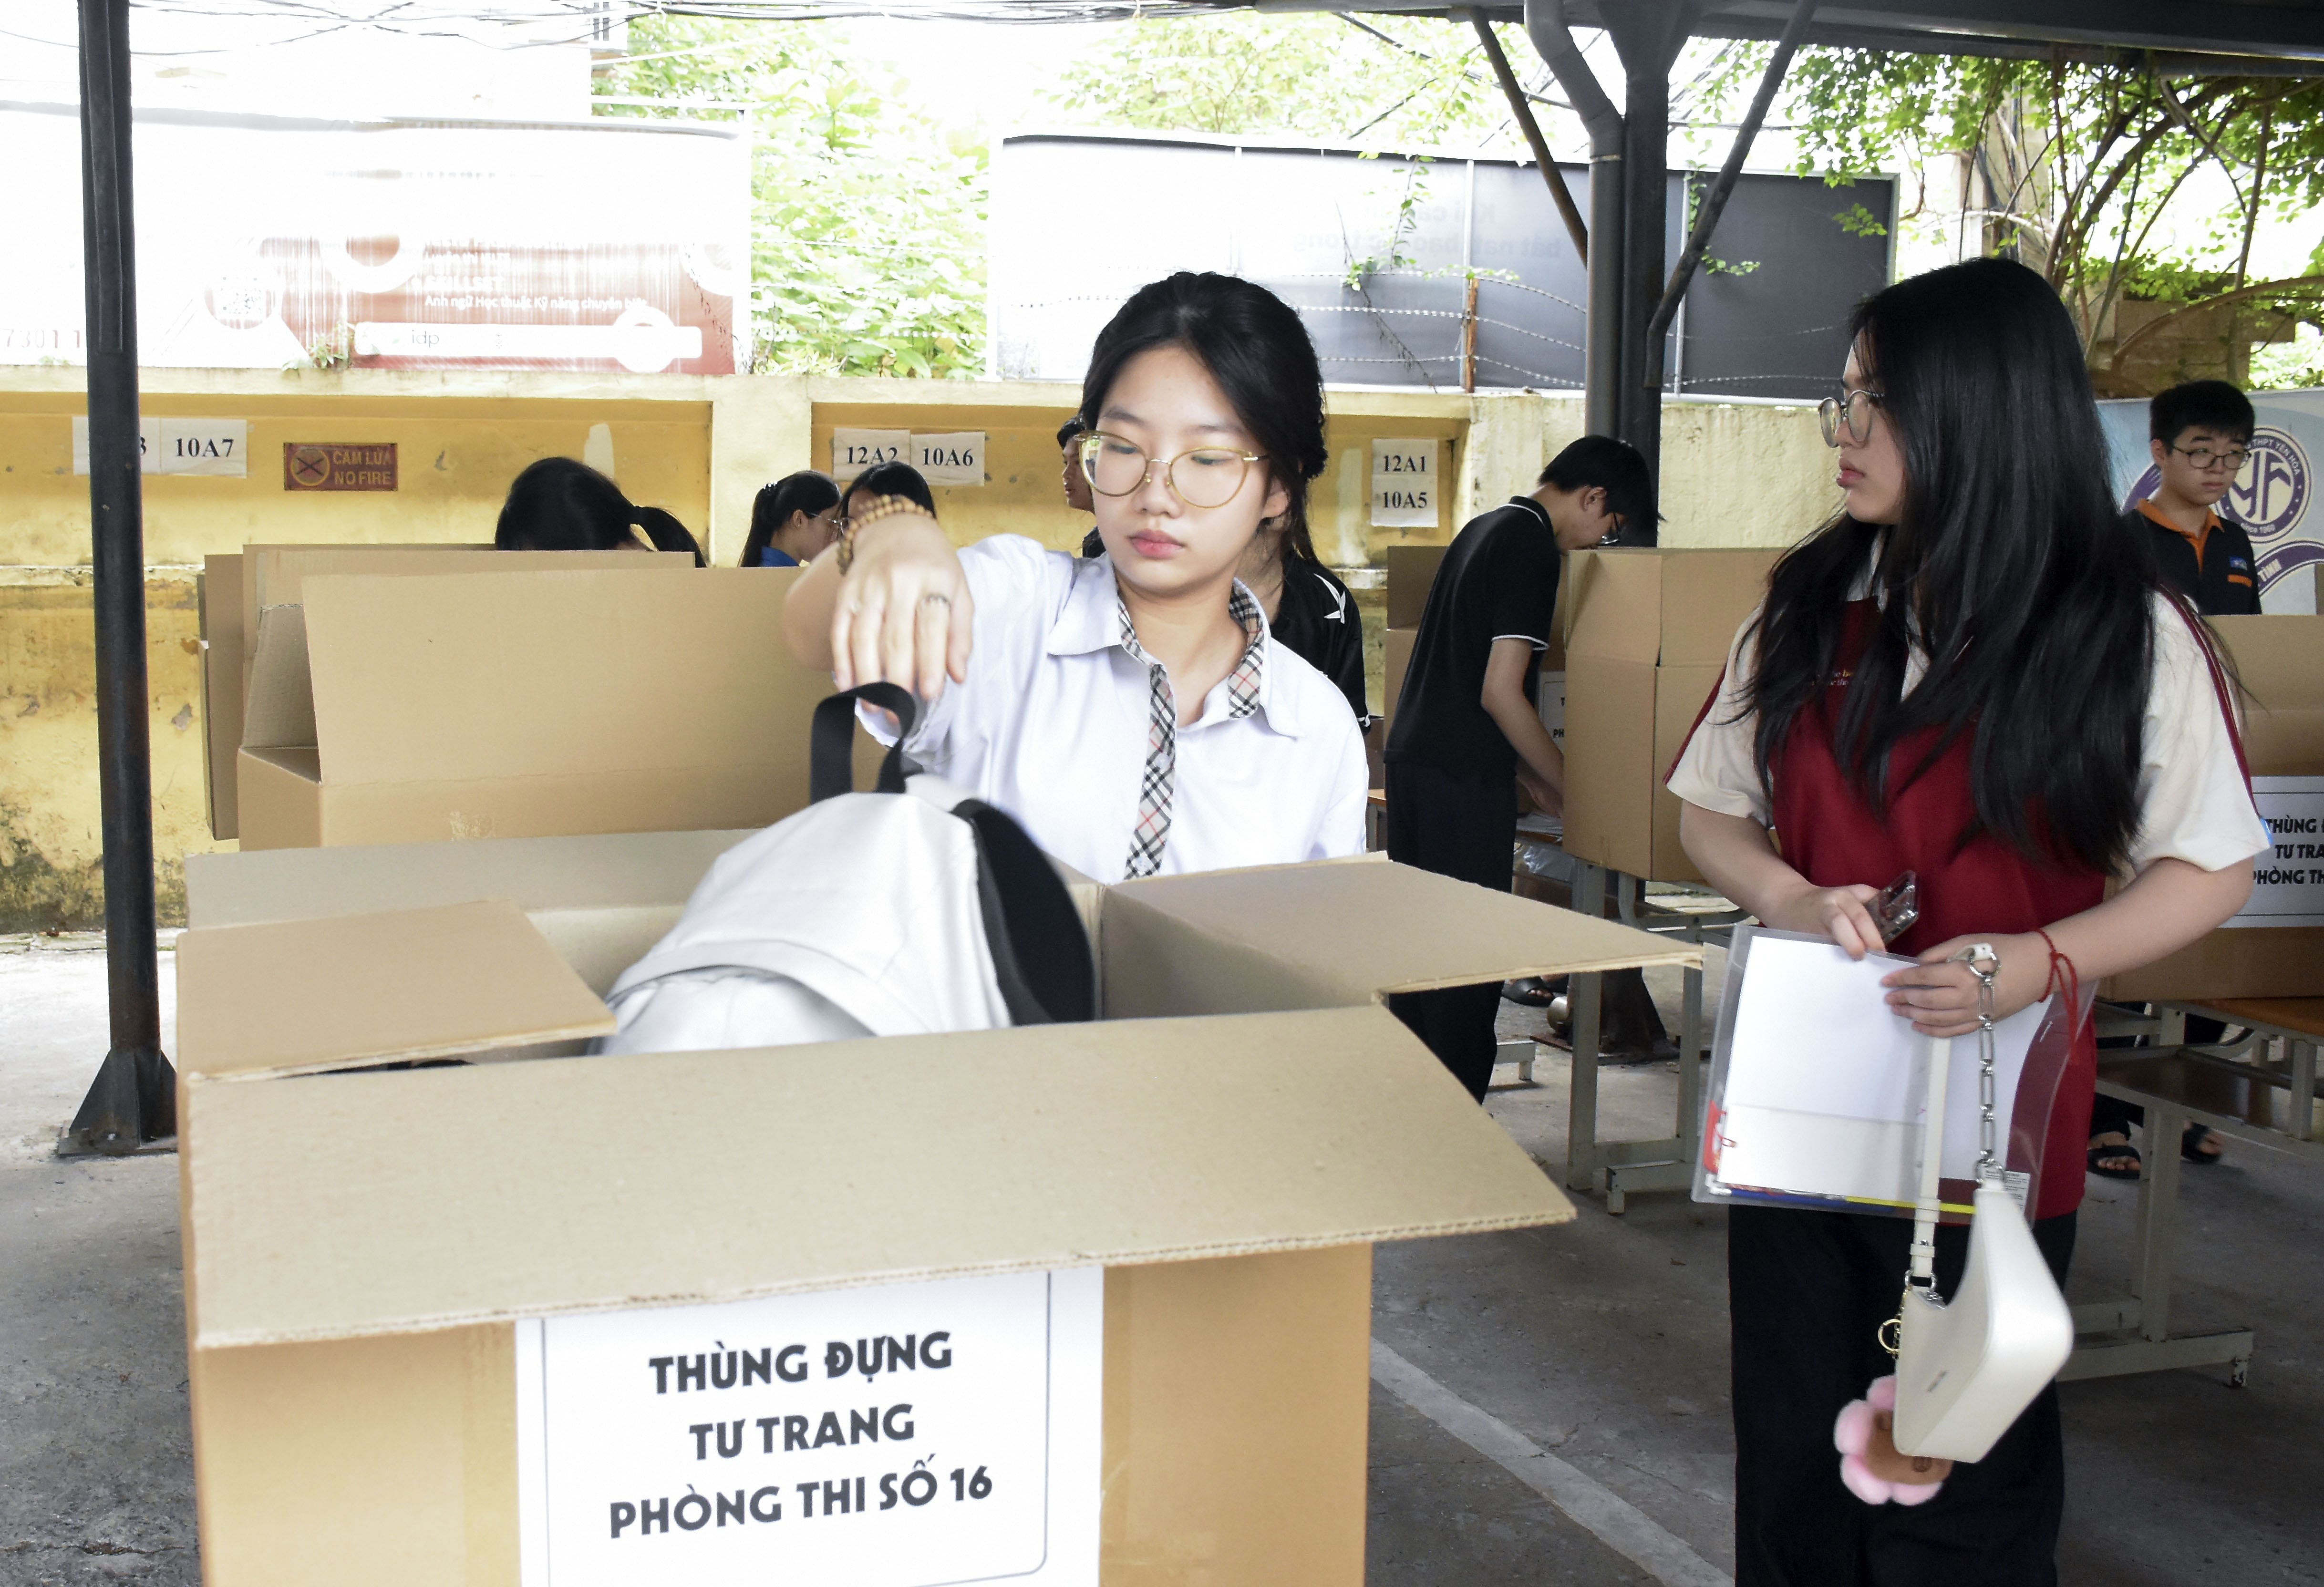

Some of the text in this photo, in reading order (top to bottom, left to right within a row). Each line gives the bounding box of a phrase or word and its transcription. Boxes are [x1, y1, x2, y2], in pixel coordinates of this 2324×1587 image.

[425, 296, 448, 306] Anh
[411, 330, 439, 348] idp
[176, 438, 234, 457] 10A7
[923, 447, 973, 466] 10A6
[1384, 455, 1426, 472] 12A1
[335, 471, 392, 485] NO FIRE
[1384, 491, 1427, 508] 10A5
[2265, 814, 2317, 834] THÙNG
[2275, 844, 2294, 859] TƯ
[649, 1331, 952, 1394] THÙNG ĐỰNG
[690, 1403, 914, 1461] TƯ TRANG
[609, 1453, 992, 1539] PHÒNG THI SỐ 16
